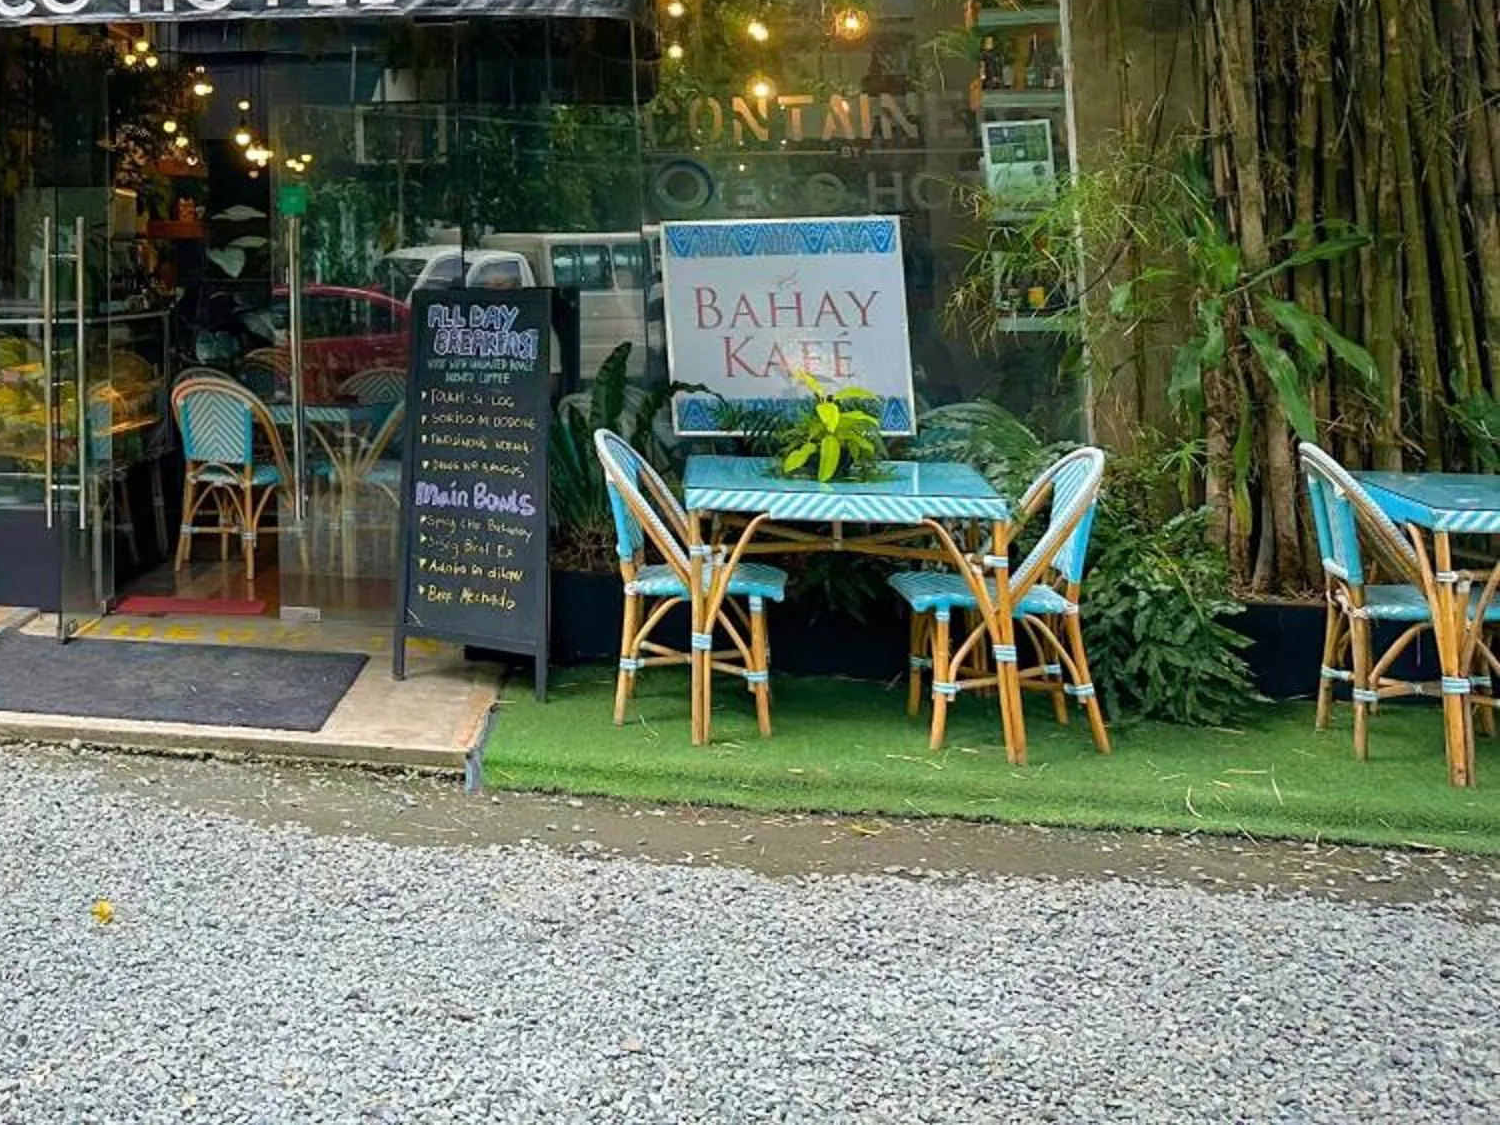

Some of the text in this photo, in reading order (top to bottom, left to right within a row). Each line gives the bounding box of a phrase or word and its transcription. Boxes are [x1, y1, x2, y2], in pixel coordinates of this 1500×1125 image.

[427, 304, 519, 334] ALL DAY
[693, 286, 880, 330] BAHAY
[433, 328, 540, 360] BREAKFAST
[719, 331, 858, 378] KAFÉ
[415, 480, 537, 516] Main Bowls
